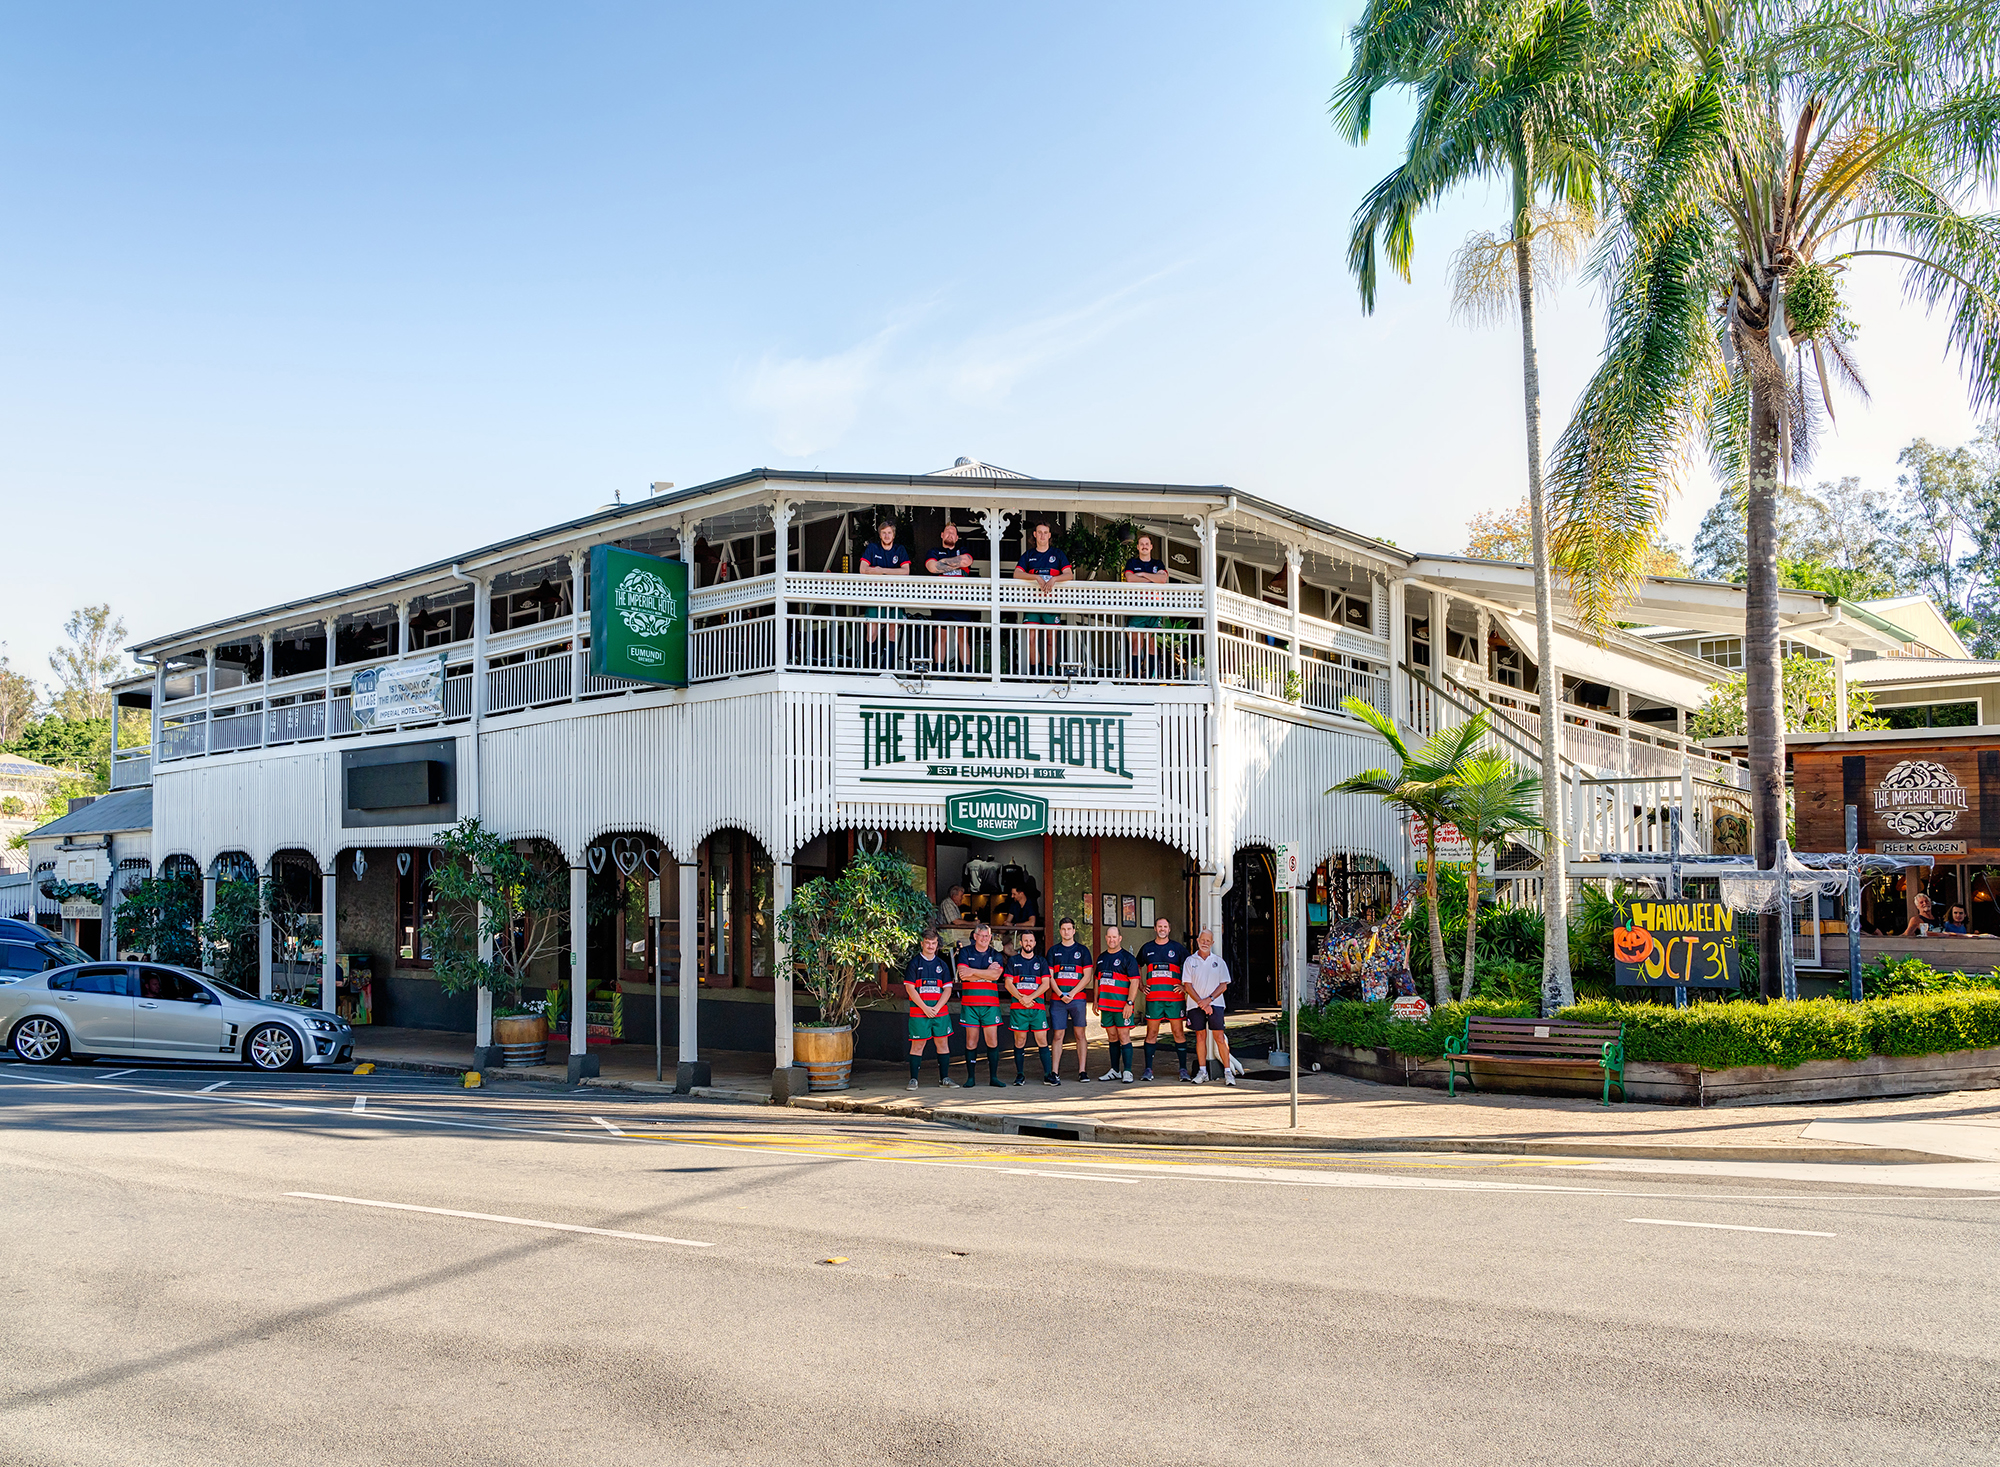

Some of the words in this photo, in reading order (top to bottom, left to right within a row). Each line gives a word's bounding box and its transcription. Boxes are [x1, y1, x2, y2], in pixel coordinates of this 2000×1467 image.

[614, 589, 626, 607] THE
[627, 592, 657, 611] IMPERIAL
[658, 599, 678, 619] HOTEL
[630, 647, 662, 660] EUMUNDI
[637, 656, 655, 664] BREWERY
[421, 679, 430, 688] OF
[355, 694, 376, 708] VINTAGE
[379, 695, 389, 705] THE
[411, 690, 428, 700] FROM
[380, 709, 400, 719] IMPERIAL
[402, 707, 418, 716] HOTEL
[859, 711, 906, 770] THE
[915, 713, 1041, 761] IMPERIAL
[1049, 716, 1134, 780] HOTEL
[936, 766, 953, 775] EST
[961, 765, 1029, 779] EUMUNDI
[1038, 769, 1057, 778] 1911
[1873, 790, 1890, 809] THE
[1891, 789, 1936, 806] IMPERIAL
[1938, 788, 1969, 809] HOTEL
[958, 802, 1037, 821] EUMUNDI
[976, 819, 1019, 830] BREWERY
[1277, 844, 1286, 857] 2P
[1918, 842, 1959, 852] GARDEN
[1644, 936, 1700, 981] OCT
